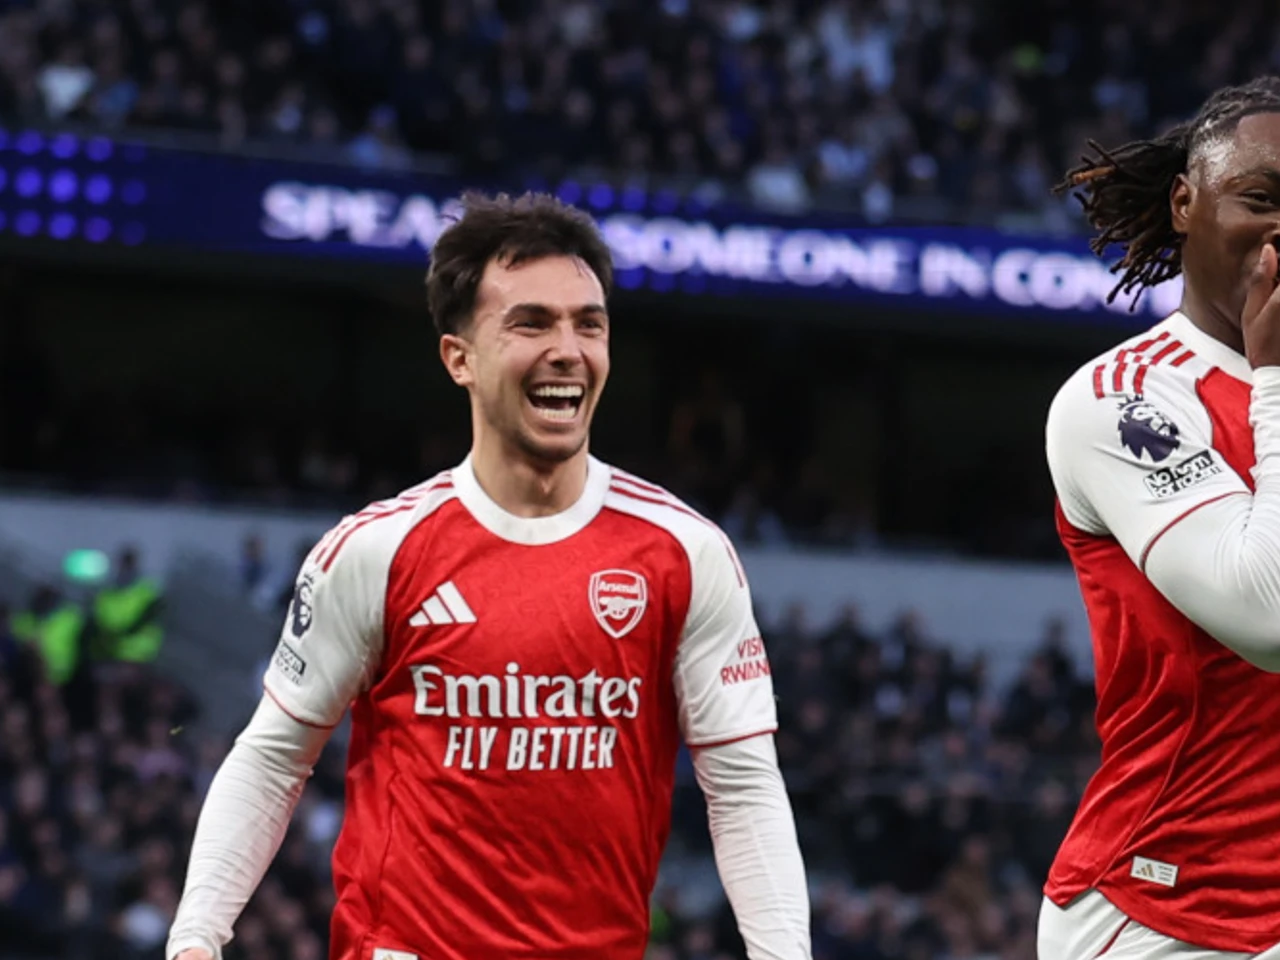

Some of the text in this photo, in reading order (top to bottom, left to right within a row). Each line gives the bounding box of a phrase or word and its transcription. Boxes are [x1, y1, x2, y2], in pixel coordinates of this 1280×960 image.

[603, 214, 917, 295] SOMEONE
[922, 243, 992, 298] IN
[598, 580, 639, 594] Arsenal
[409, 661, 642, 719] Emirates
[443, 726, 617, 771] FLY BETTER
